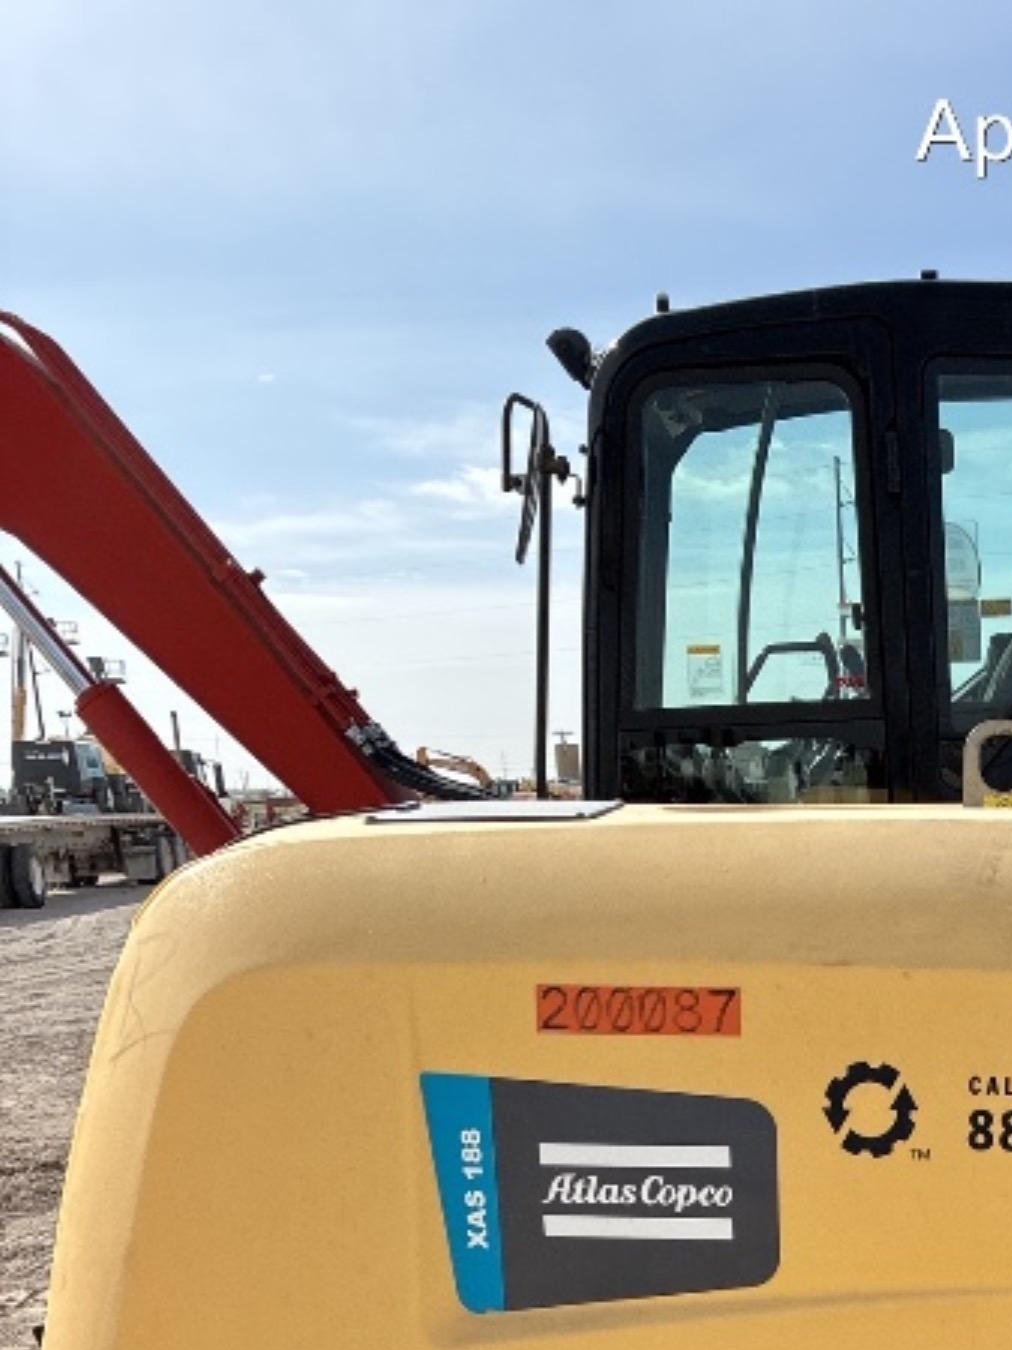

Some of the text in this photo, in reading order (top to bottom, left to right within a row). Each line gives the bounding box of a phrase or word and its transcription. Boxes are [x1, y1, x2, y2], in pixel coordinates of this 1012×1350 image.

[541, 987, 737, 1034] 200087
[461, 1128, 490, 1249] XAS 188
